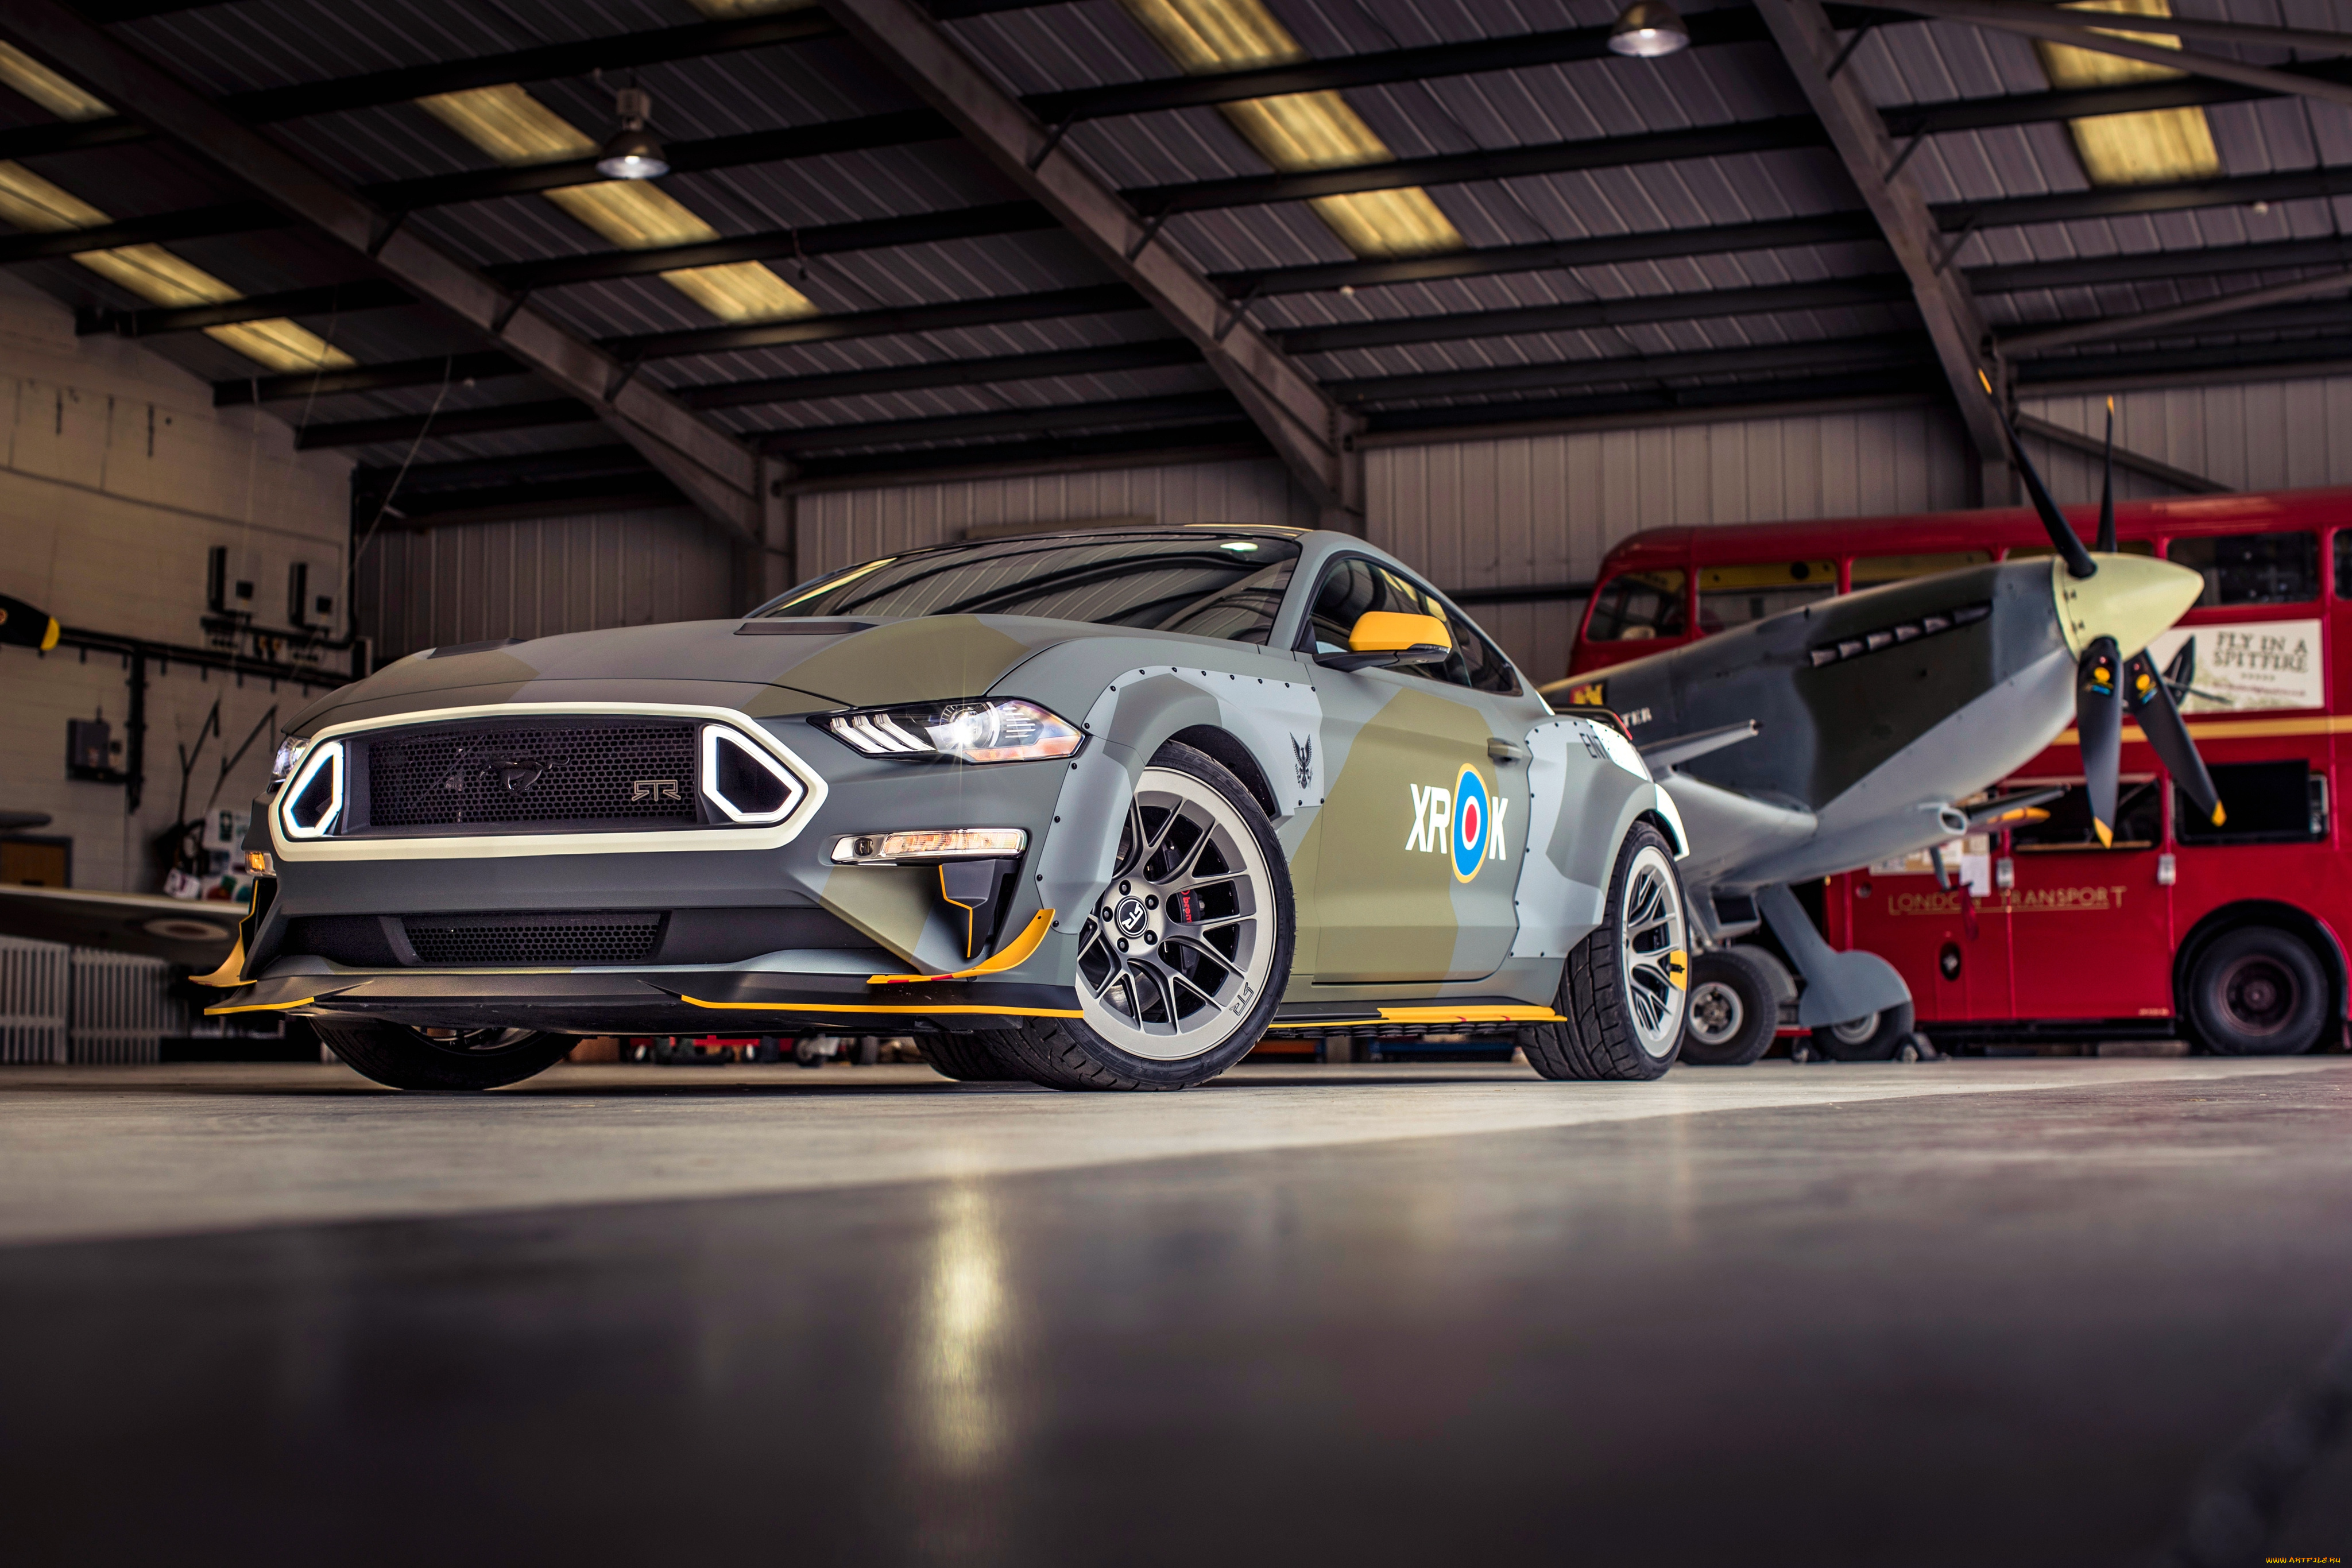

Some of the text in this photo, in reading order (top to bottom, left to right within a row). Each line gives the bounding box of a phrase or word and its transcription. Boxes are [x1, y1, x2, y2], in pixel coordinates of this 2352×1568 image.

[2218, 632, 2308, 655] FLY IN A
[2214, 649, 2308, 673] SPITFIRE
[1620, 707, 1652, 728] TER
[632, 779, 681, 802] RTR
[1999, 886, 2127, 908] TRANSPORT
[1121, 903, 1144, 930] RTR
[1183, 897, 1193, 923] brem
[1229, 982, 1254, 1016] RTR
